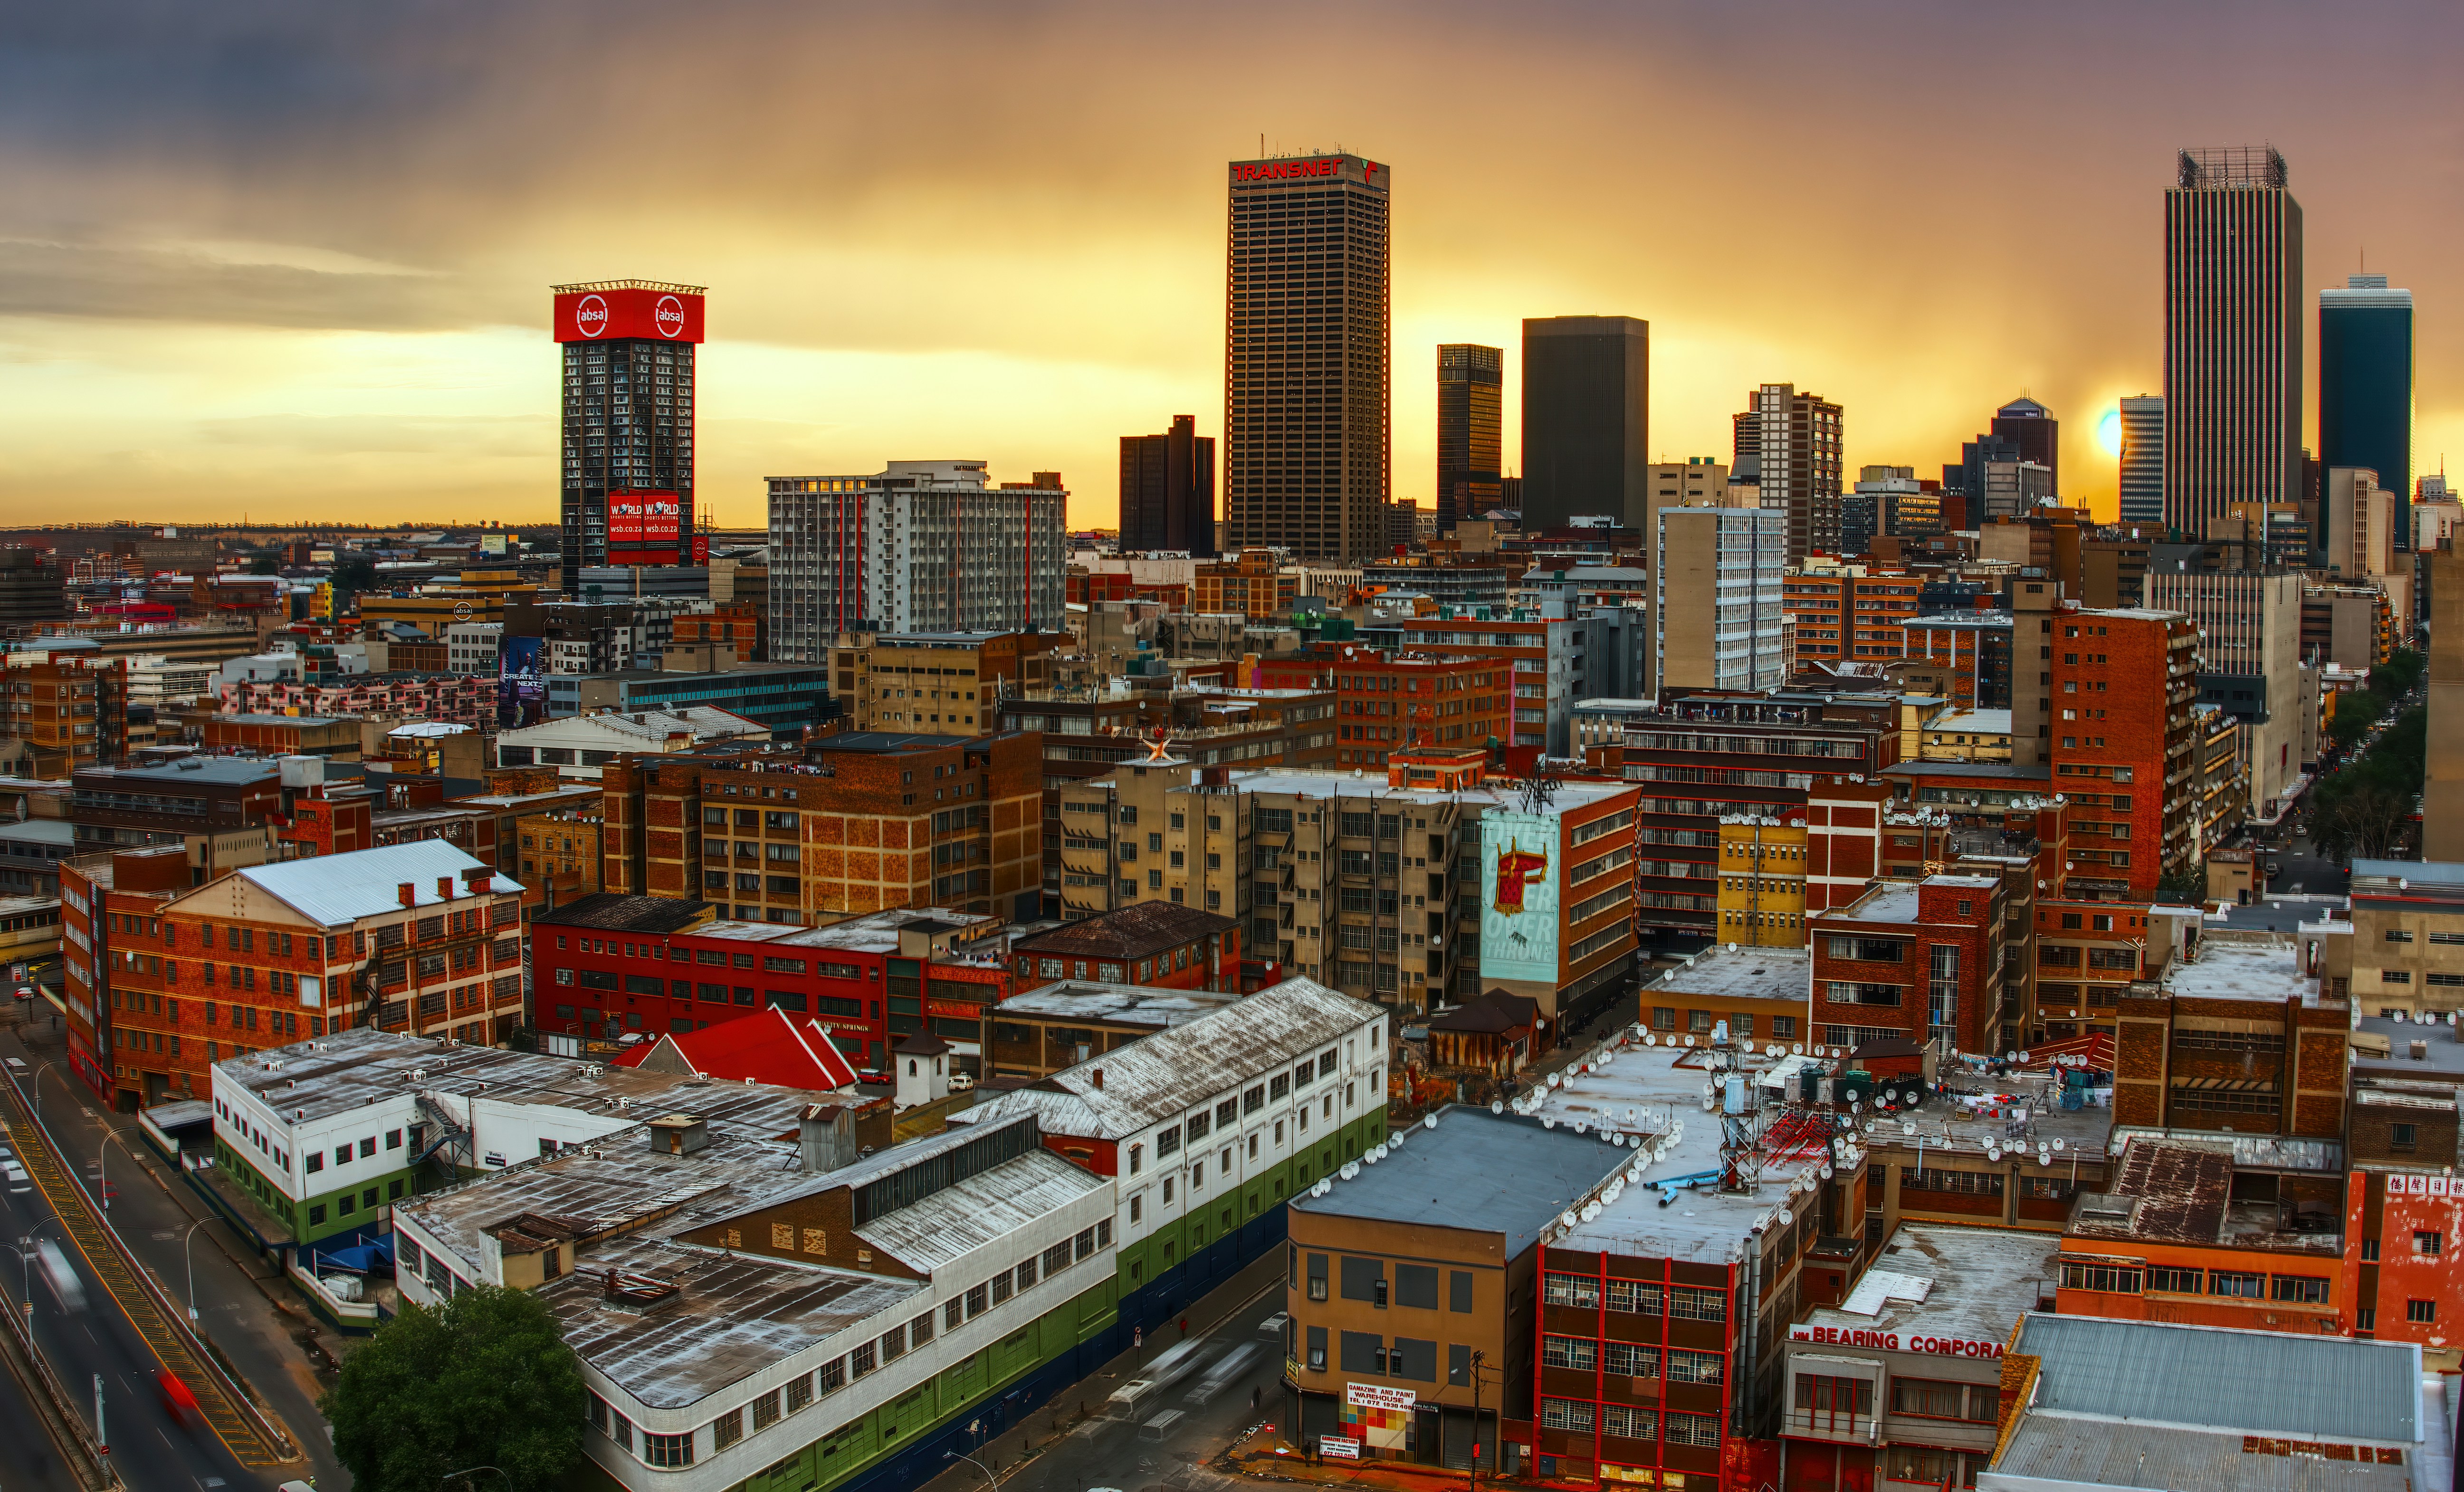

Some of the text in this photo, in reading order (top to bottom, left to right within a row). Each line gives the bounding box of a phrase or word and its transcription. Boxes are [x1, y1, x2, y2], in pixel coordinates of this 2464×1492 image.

[1232, 159, 1343, 181] TRANSNET
[581, 307, 604, 321] absa
[659, 307, 680, 322] absa
[611, 504, 642, 515] WORLD
[645, 502, 679, 515] WORLD
[611, 525, 642, 533] wsb.co.za
[646, 524, 678, 533] wsb.co.za
[1486, 940, 1554, 961] THRONE
[843, 1023, 869, 1032] SPRINGS
[1793, 1331, 1809, 1341] HM
[1813, 1326, 1899, 1349] BEARING
[1355, 1392, 1404, 1404] WAREHOUSE
[1396, 1390, 1414, 1398] PAINT
